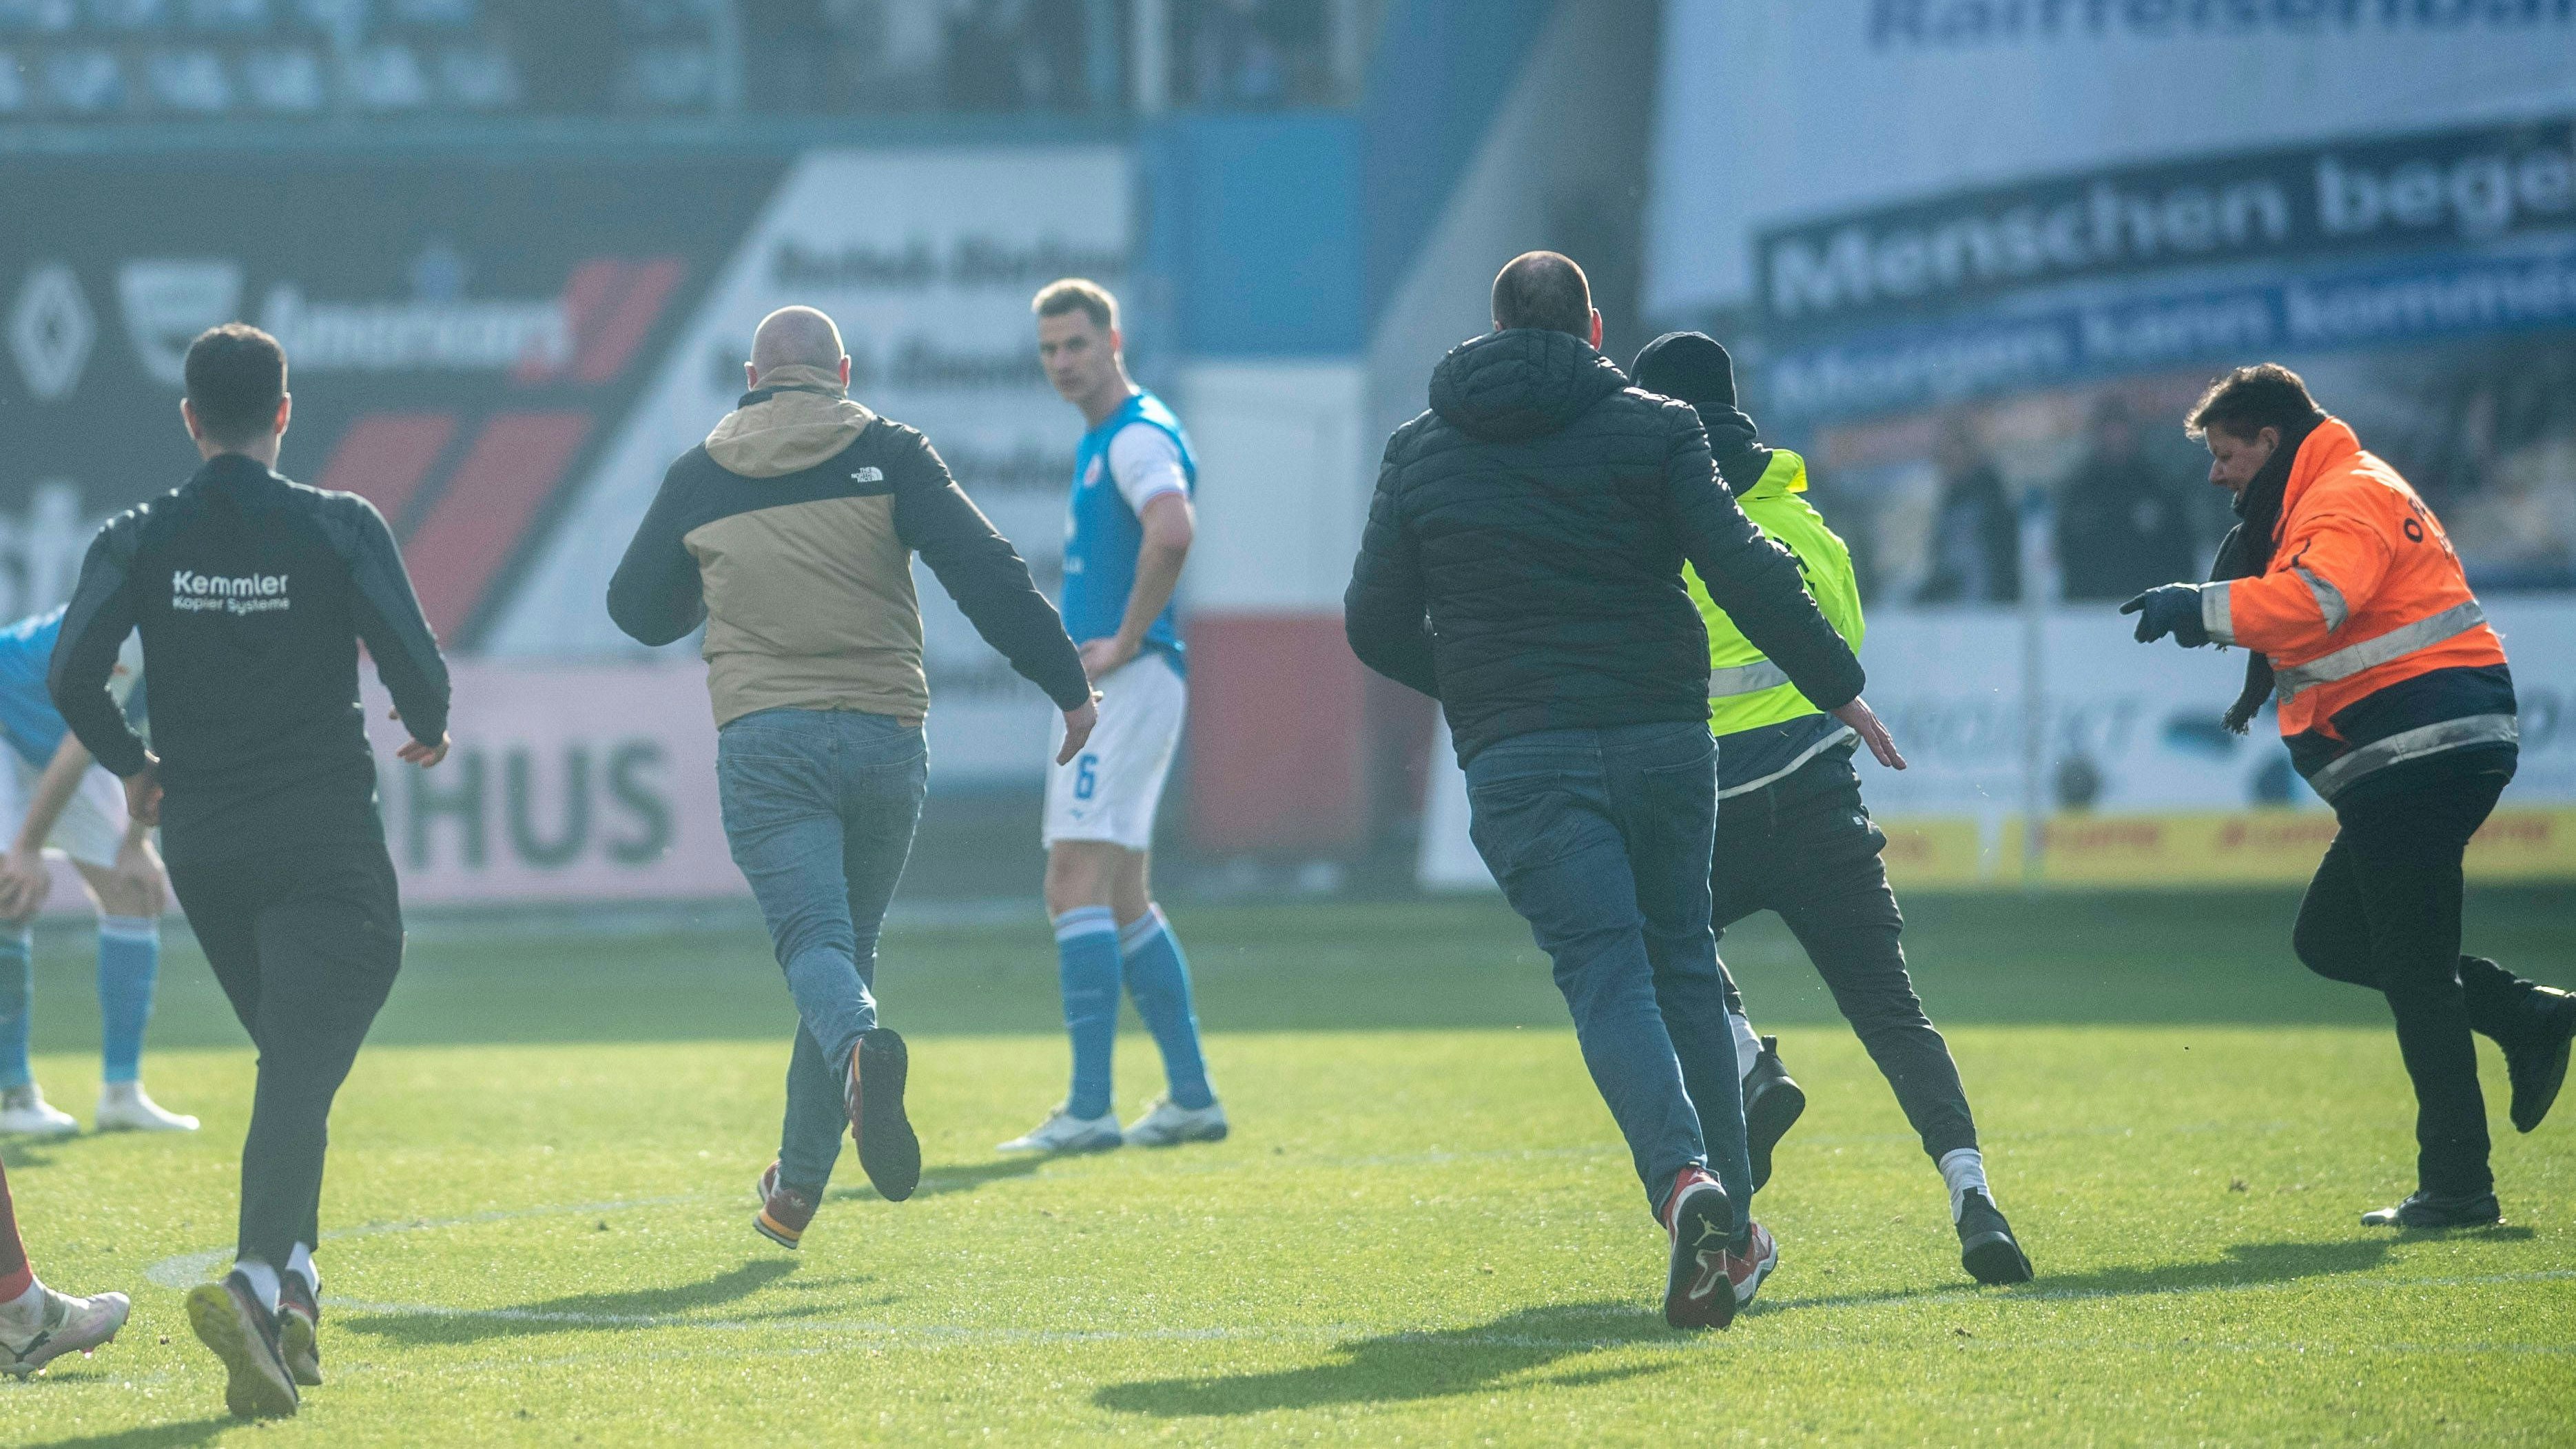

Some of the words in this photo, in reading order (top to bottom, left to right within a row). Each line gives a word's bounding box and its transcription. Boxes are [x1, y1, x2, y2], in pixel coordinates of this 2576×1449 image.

[1775, 181, 2286, 314] Menschen
[172, 570, 289, 597] Kemmler
[172, 596, 225, 613] Kopier
[226, 597, 291, 617] Systeme
[1075, 752, 1098, 800] 6
